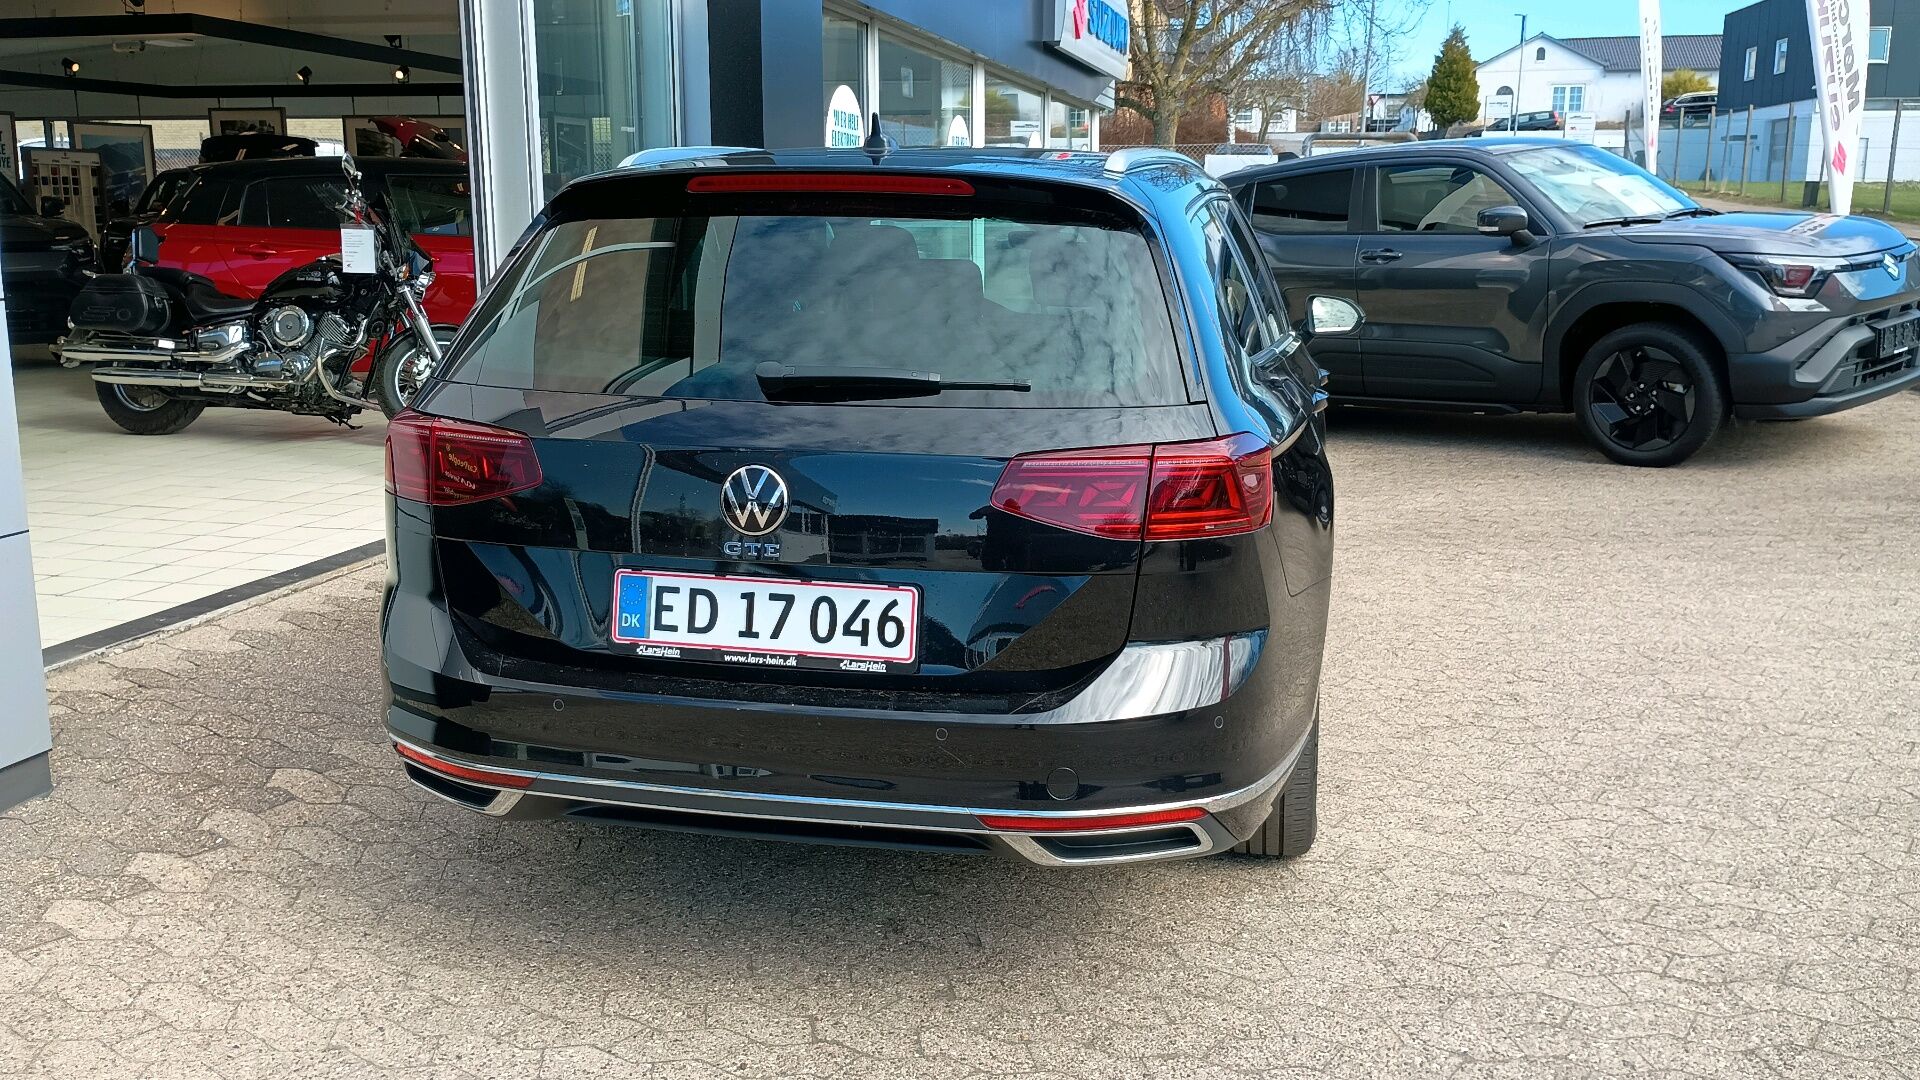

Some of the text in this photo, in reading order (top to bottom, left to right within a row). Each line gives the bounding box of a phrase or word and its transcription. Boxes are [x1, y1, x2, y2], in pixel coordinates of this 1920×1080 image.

[1087, 0, 1128, 56] SUZUKI
[723, 541, 780, 558] GTE
[621, 613, 641, 628] DK
[653, 585, 905, 649] ED 17 046
[642, 645, 681, 657] LarsHein
[724, 653, 798, 667] www.lars-hein.dk
[846, 659, 887, 672] LarsHein
